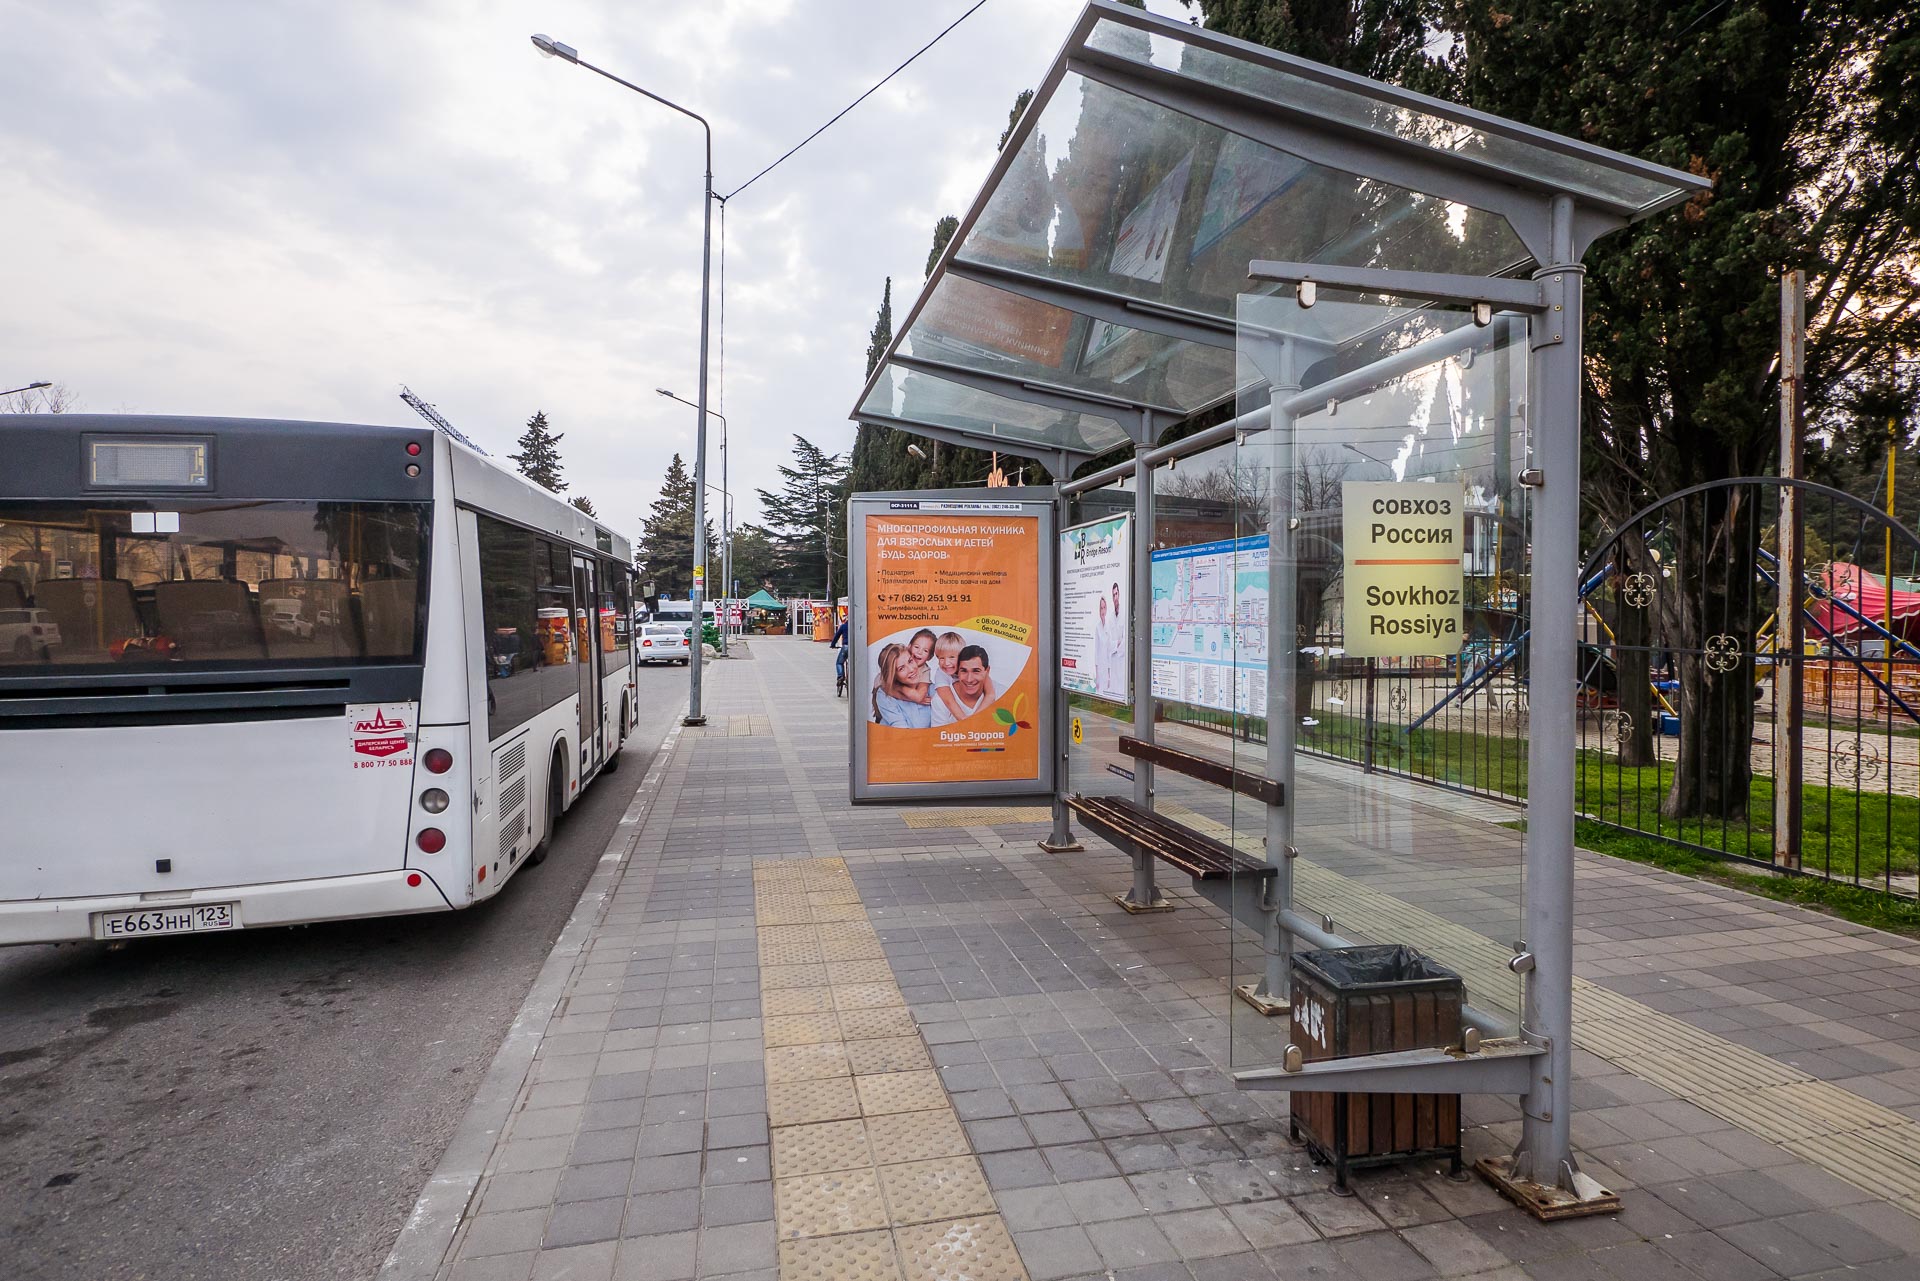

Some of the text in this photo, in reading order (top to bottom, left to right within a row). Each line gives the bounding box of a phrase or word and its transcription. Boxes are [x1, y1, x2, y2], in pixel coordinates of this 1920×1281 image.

[1372, 499, 1451, 515] совхоз
[877, 524, 1025, 535] МНОГОПРОФИЛЬНАЯ КЛИНИКА
[1371, 523, 1452, 543] Россия
[877, 537, 993, 548] ДЛЯ ВЗРОСЛЫХ И ДЕТЕЙ
[888, 594, 971, 603] +7 (862) 251 91 91
[1366, 585, 1460, 606] Sovkhoz
[878, 612, 939, 620] www.bzsochi.ru
[981, 618, 1000, 626] 08:00
[1009, 623, 1027, 634] 21:00
[1370, 614, 1456, 638] Rossiya
[196, 906, 227, 922] 123
